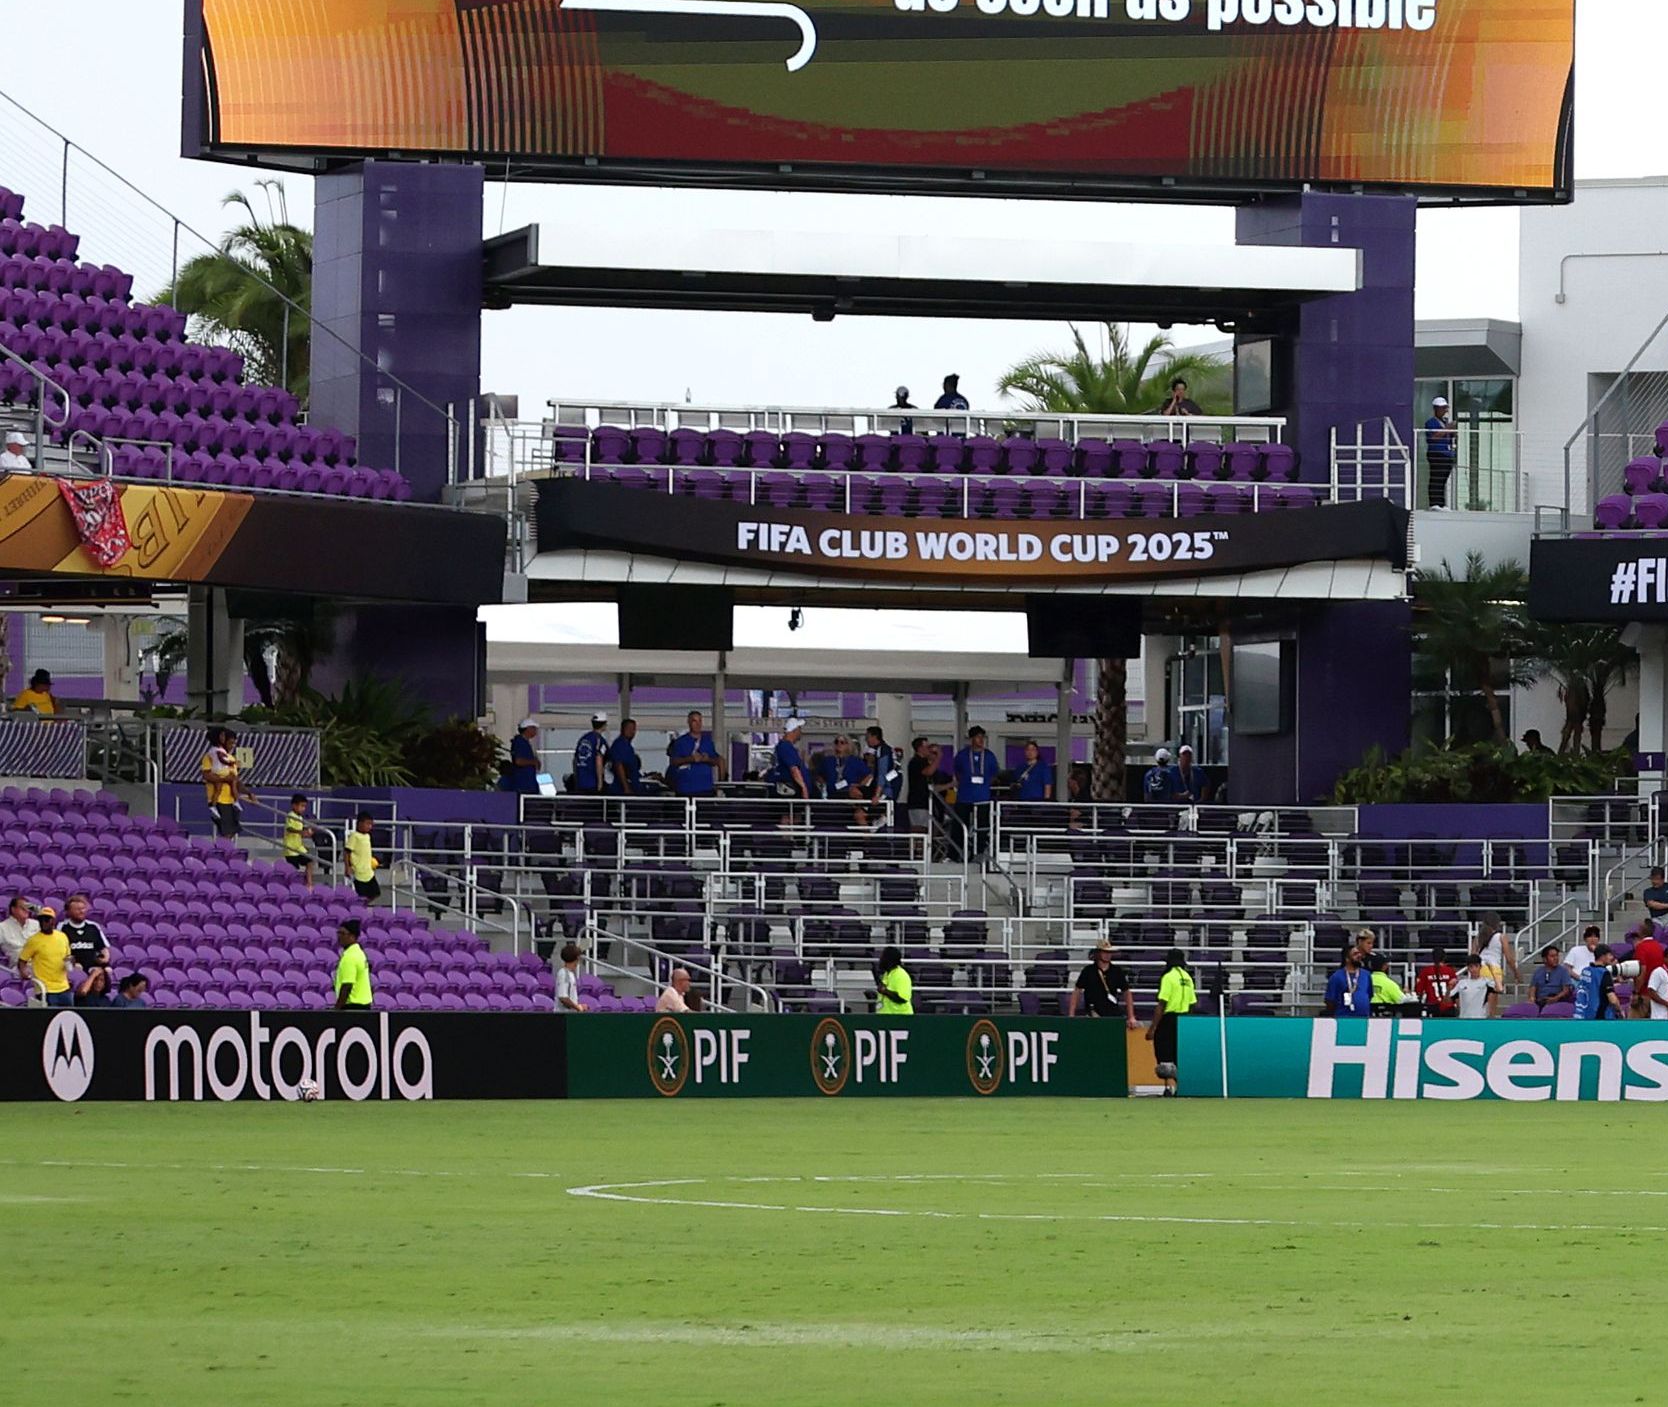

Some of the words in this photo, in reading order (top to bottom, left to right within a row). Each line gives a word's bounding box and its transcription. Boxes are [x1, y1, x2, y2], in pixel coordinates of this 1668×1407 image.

[737, 521, 812, 555] FIFA
[817, 528, 909, 559] CLUB
[914, 530, 1044, 562] WORLD
[1049, 533, 1120, 563] CUP
[1646, 755, 1653, 768] 1
[144, 1011, 433, 1102] motorola
[693, 1028, 750, 1084] PIF
[854, 1028, 909, 1084] PIF
[1007, 1031, 1060, 1084] PIF
